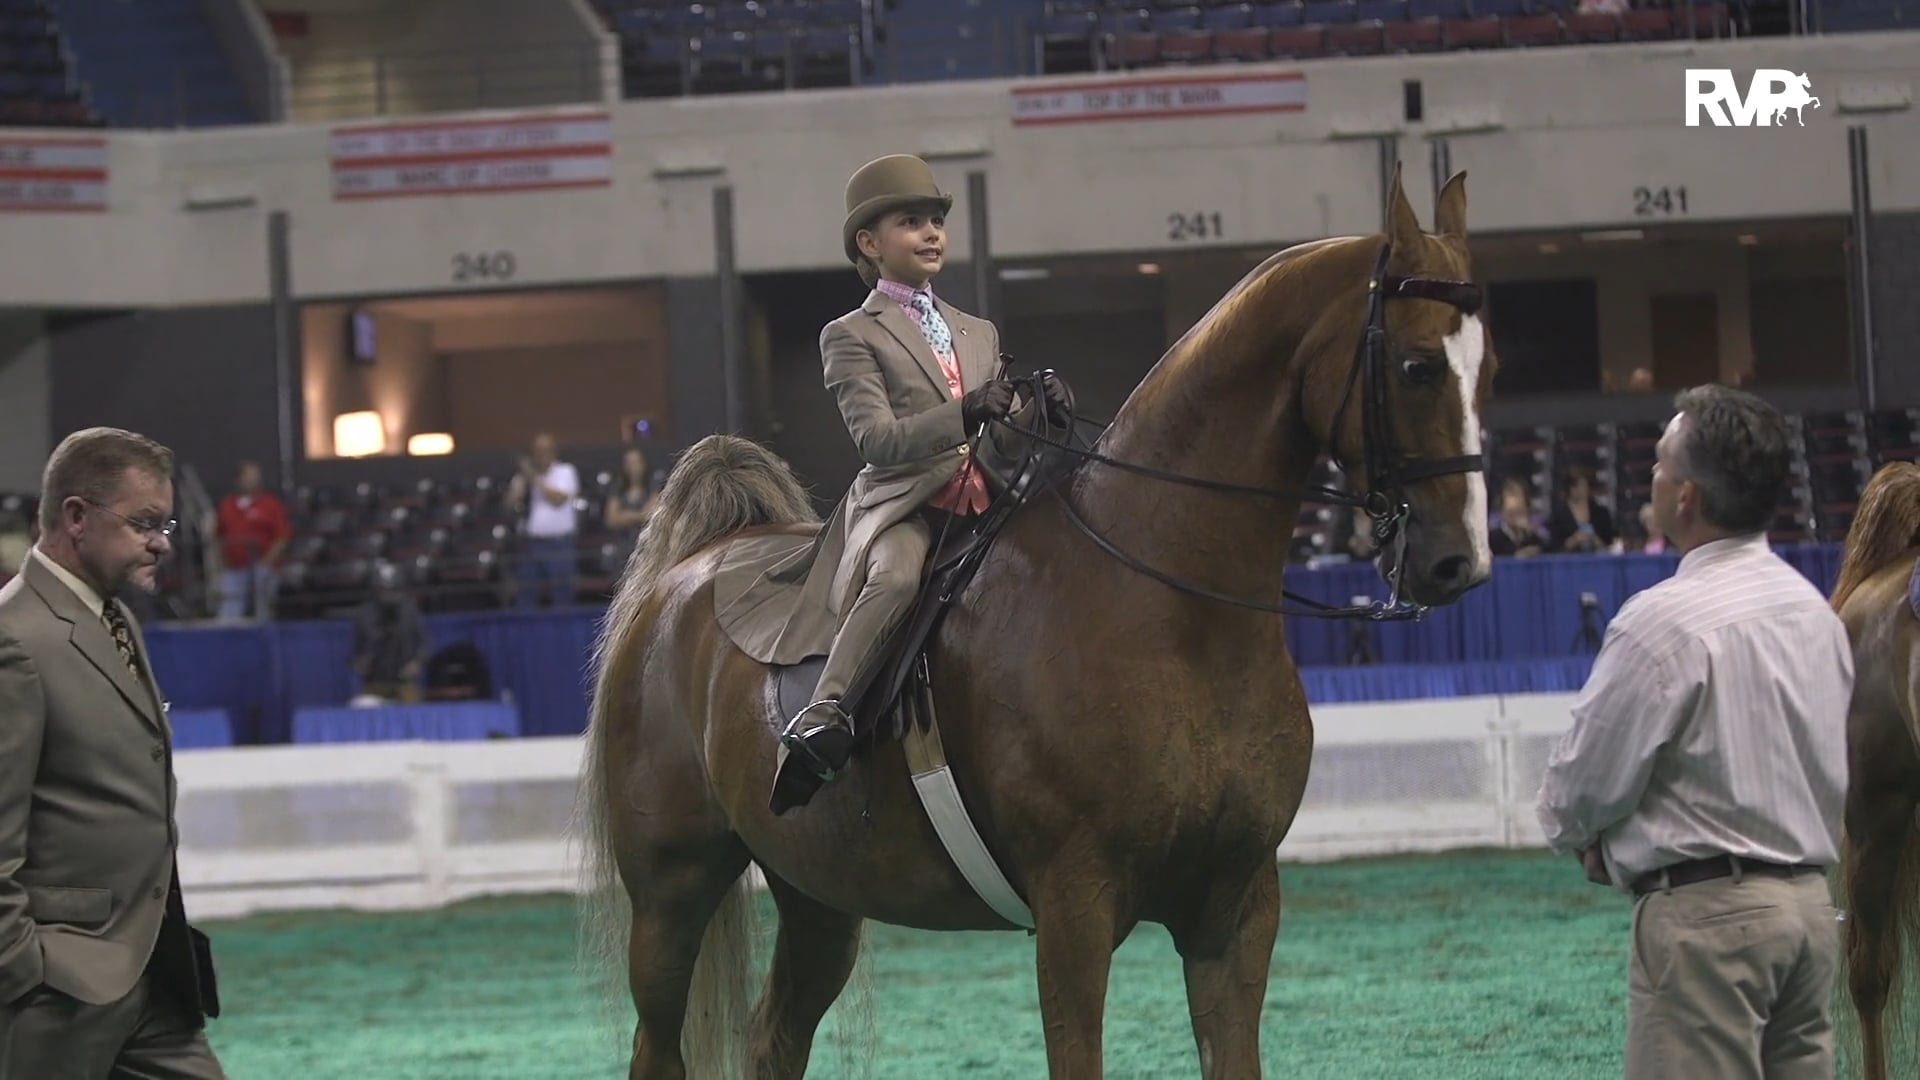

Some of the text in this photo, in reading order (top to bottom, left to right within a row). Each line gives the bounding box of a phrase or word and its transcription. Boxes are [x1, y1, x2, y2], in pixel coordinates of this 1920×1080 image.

[1634, 186, 1688, 216] 241
[1167, 212, 1223, 241] 241
[451, 251, 517, 282] 240
